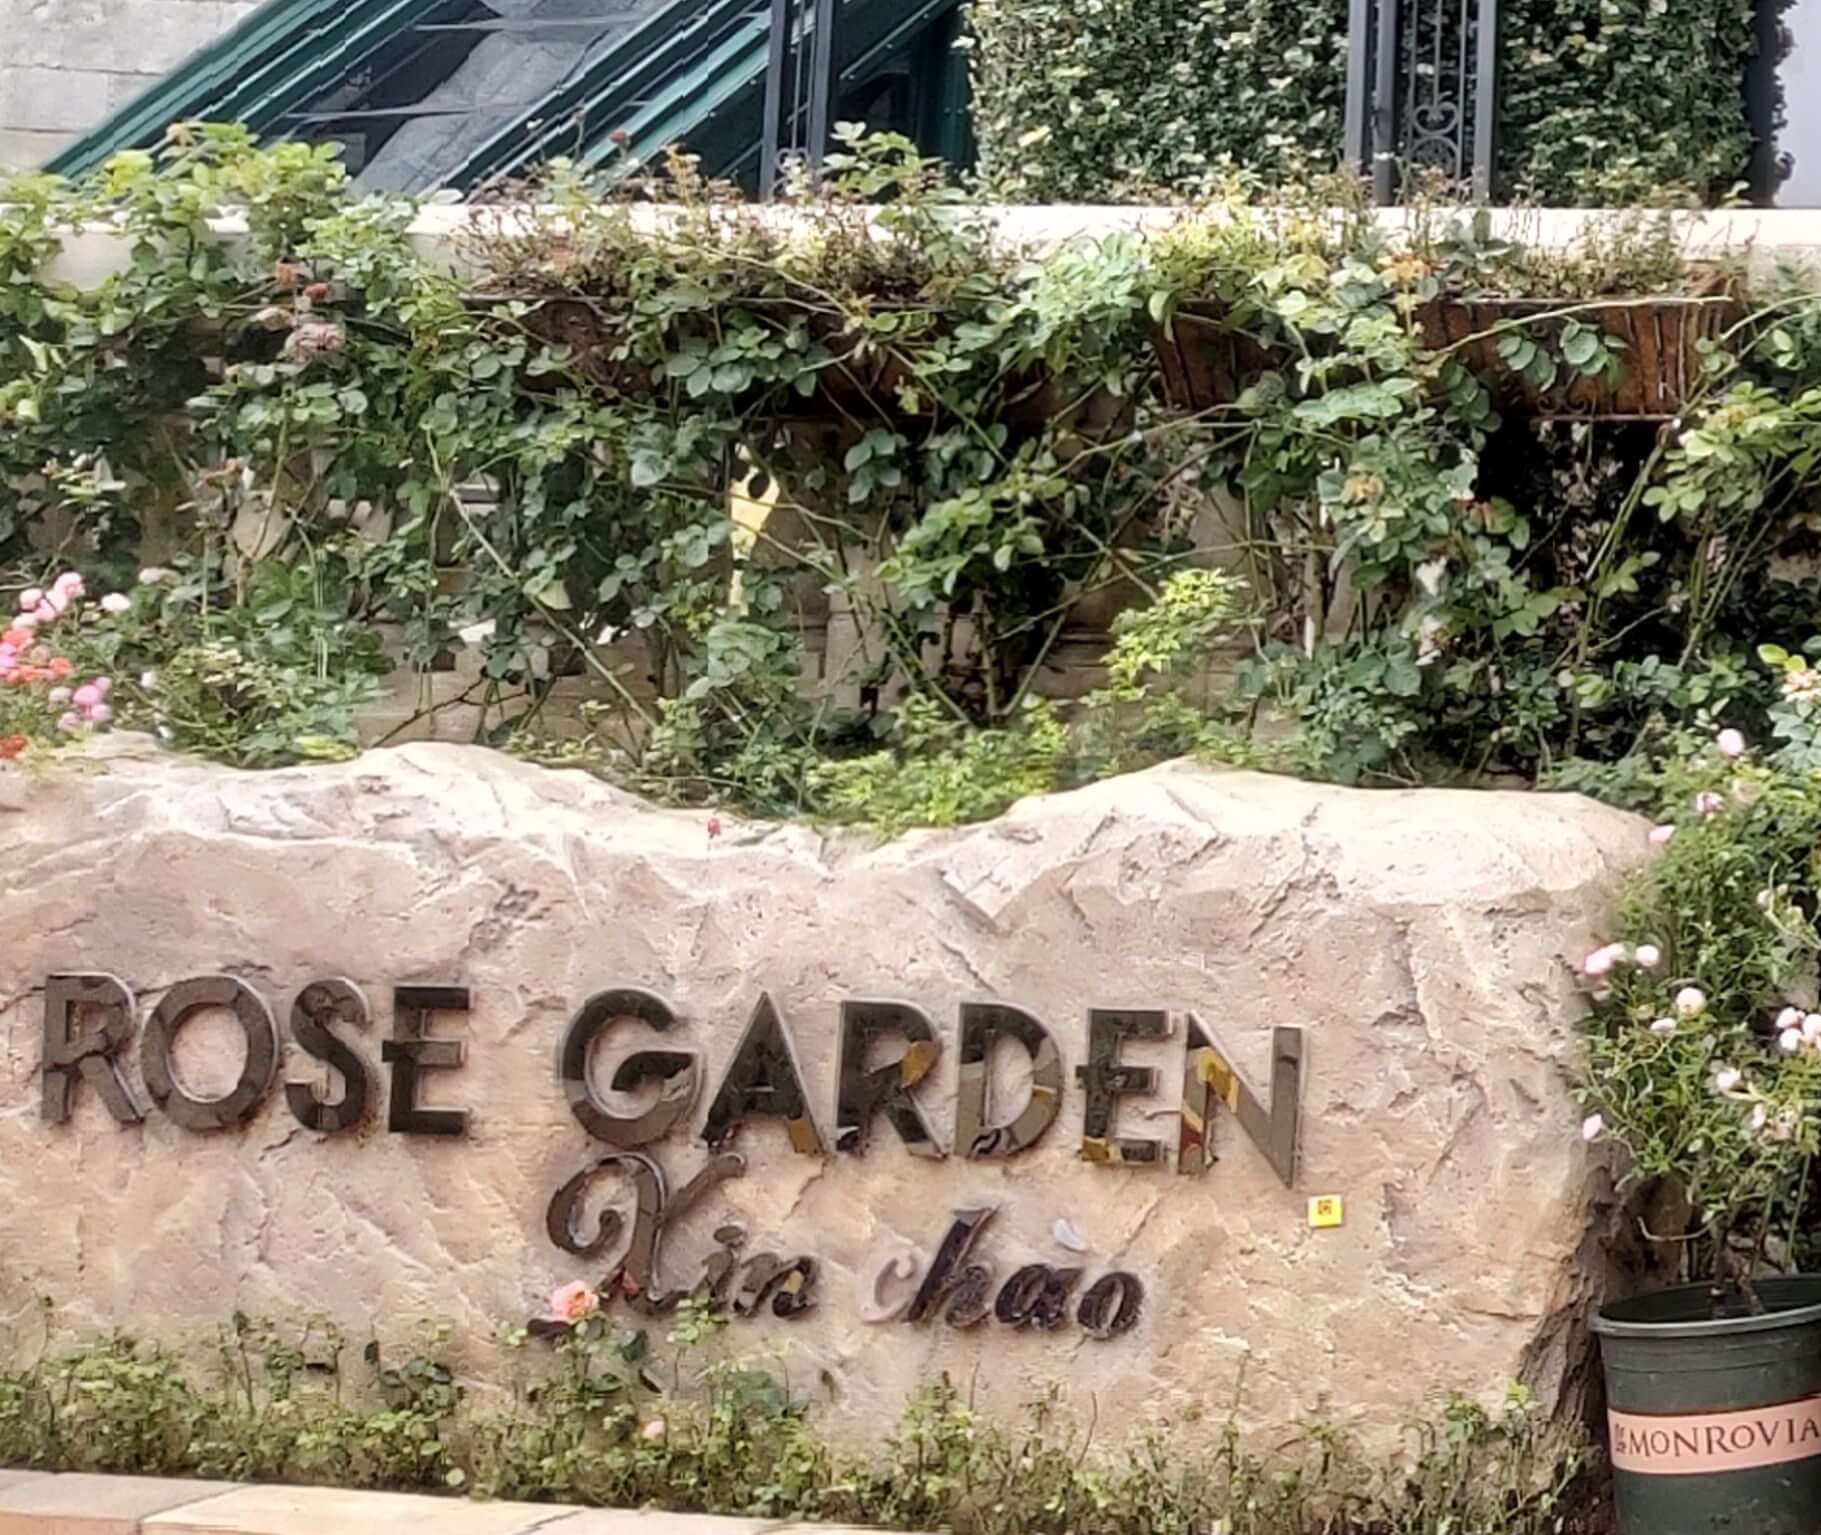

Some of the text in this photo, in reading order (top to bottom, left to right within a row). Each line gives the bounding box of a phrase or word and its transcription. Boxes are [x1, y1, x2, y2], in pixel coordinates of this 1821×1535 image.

[40, 973, 1306, 1189] ROSE GARDEN
[1628, 1417, 1821, 1457] MONROVIA
